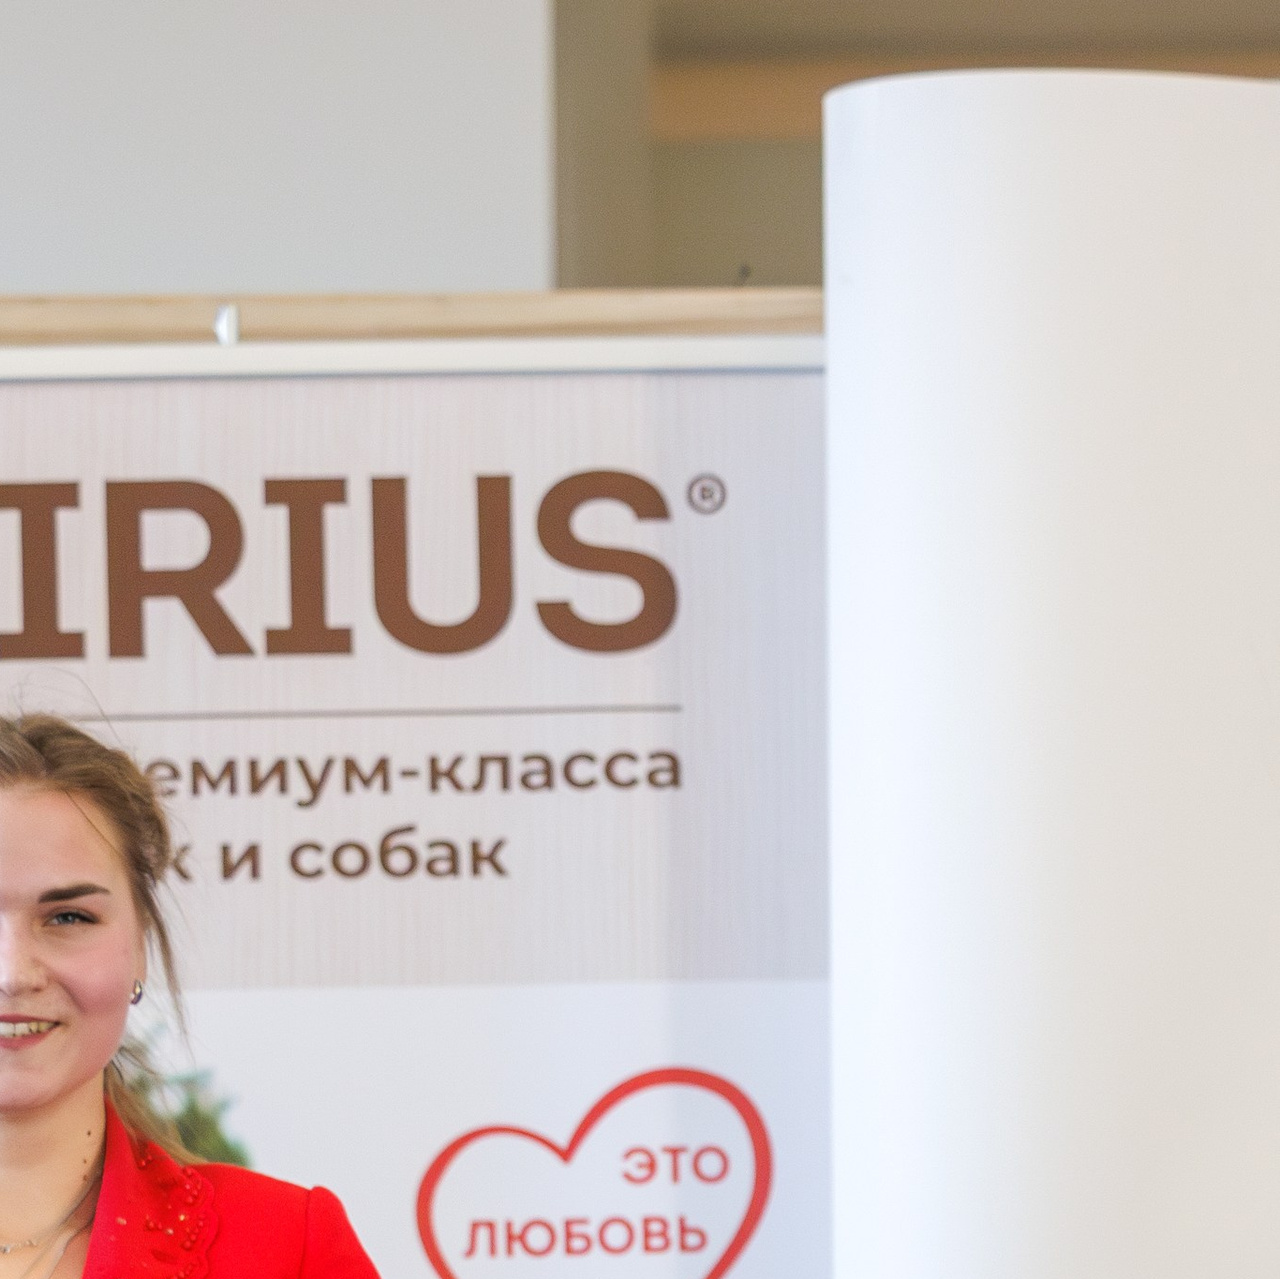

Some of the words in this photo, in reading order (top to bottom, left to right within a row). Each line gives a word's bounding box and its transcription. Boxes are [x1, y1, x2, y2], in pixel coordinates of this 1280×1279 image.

[145, 748, 683, 809] емиум-класса
[220, 841, 261, 881] и
[289, 824, 510, 880] собак
[620, 1145, 730, 1185] ЭТО
[463, 1216, 709, 1259] ЛЮБОВЬ
